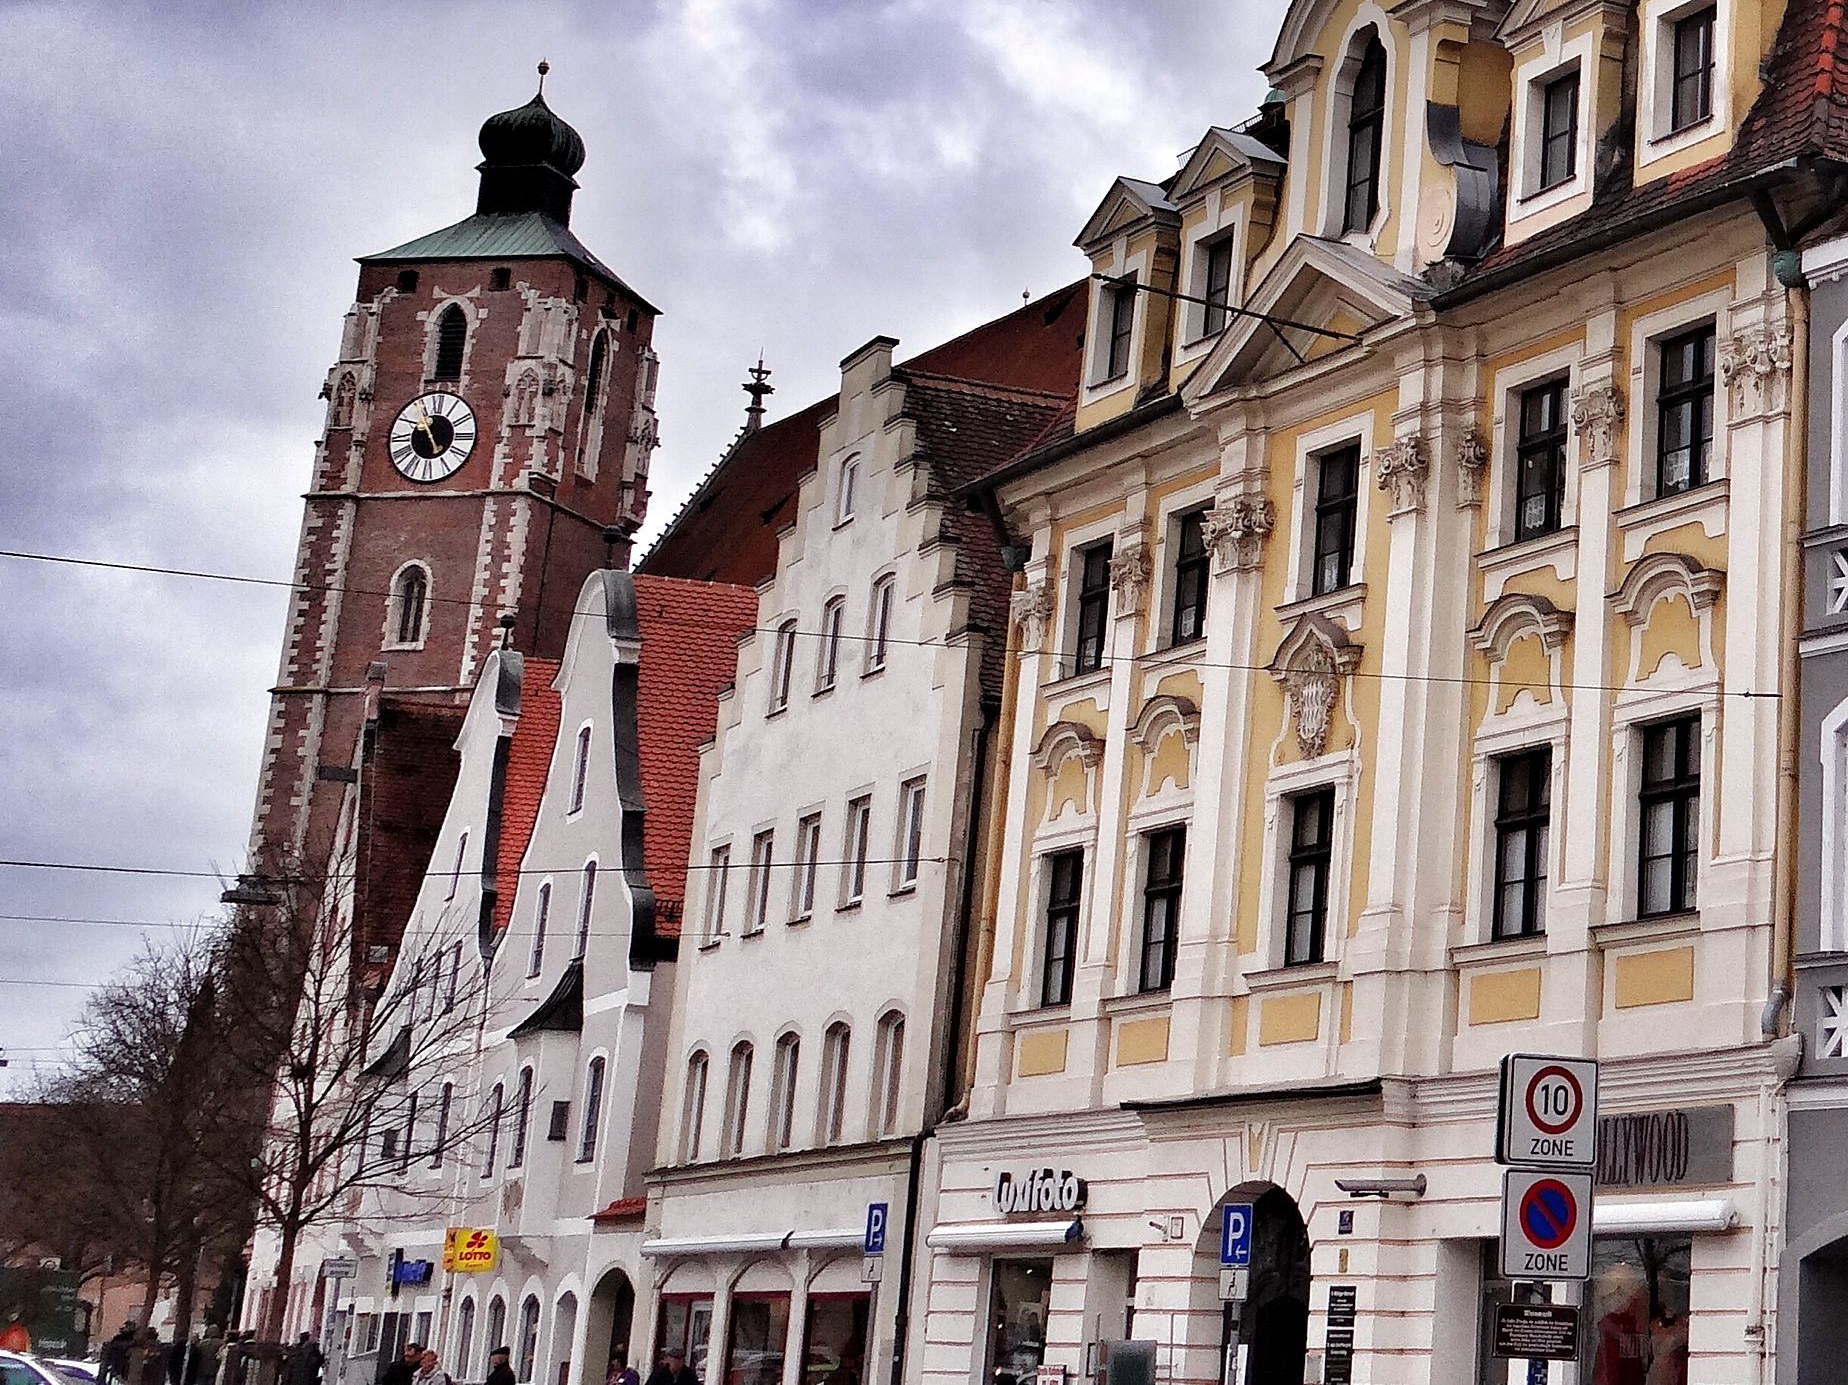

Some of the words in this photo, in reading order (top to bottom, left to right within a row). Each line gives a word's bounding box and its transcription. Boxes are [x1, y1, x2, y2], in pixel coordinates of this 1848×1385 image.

[1540, 1083, 1569, 1116] 10
[1530, 1138, 1575, 1157] ZONE
[868, 1209, 883, 1247] P
[1228, 1212, 1245, 1257] P
[459, 1251, 492, 1261] LOTTO
[1524, 1253, 1569, 1272] ZONE
